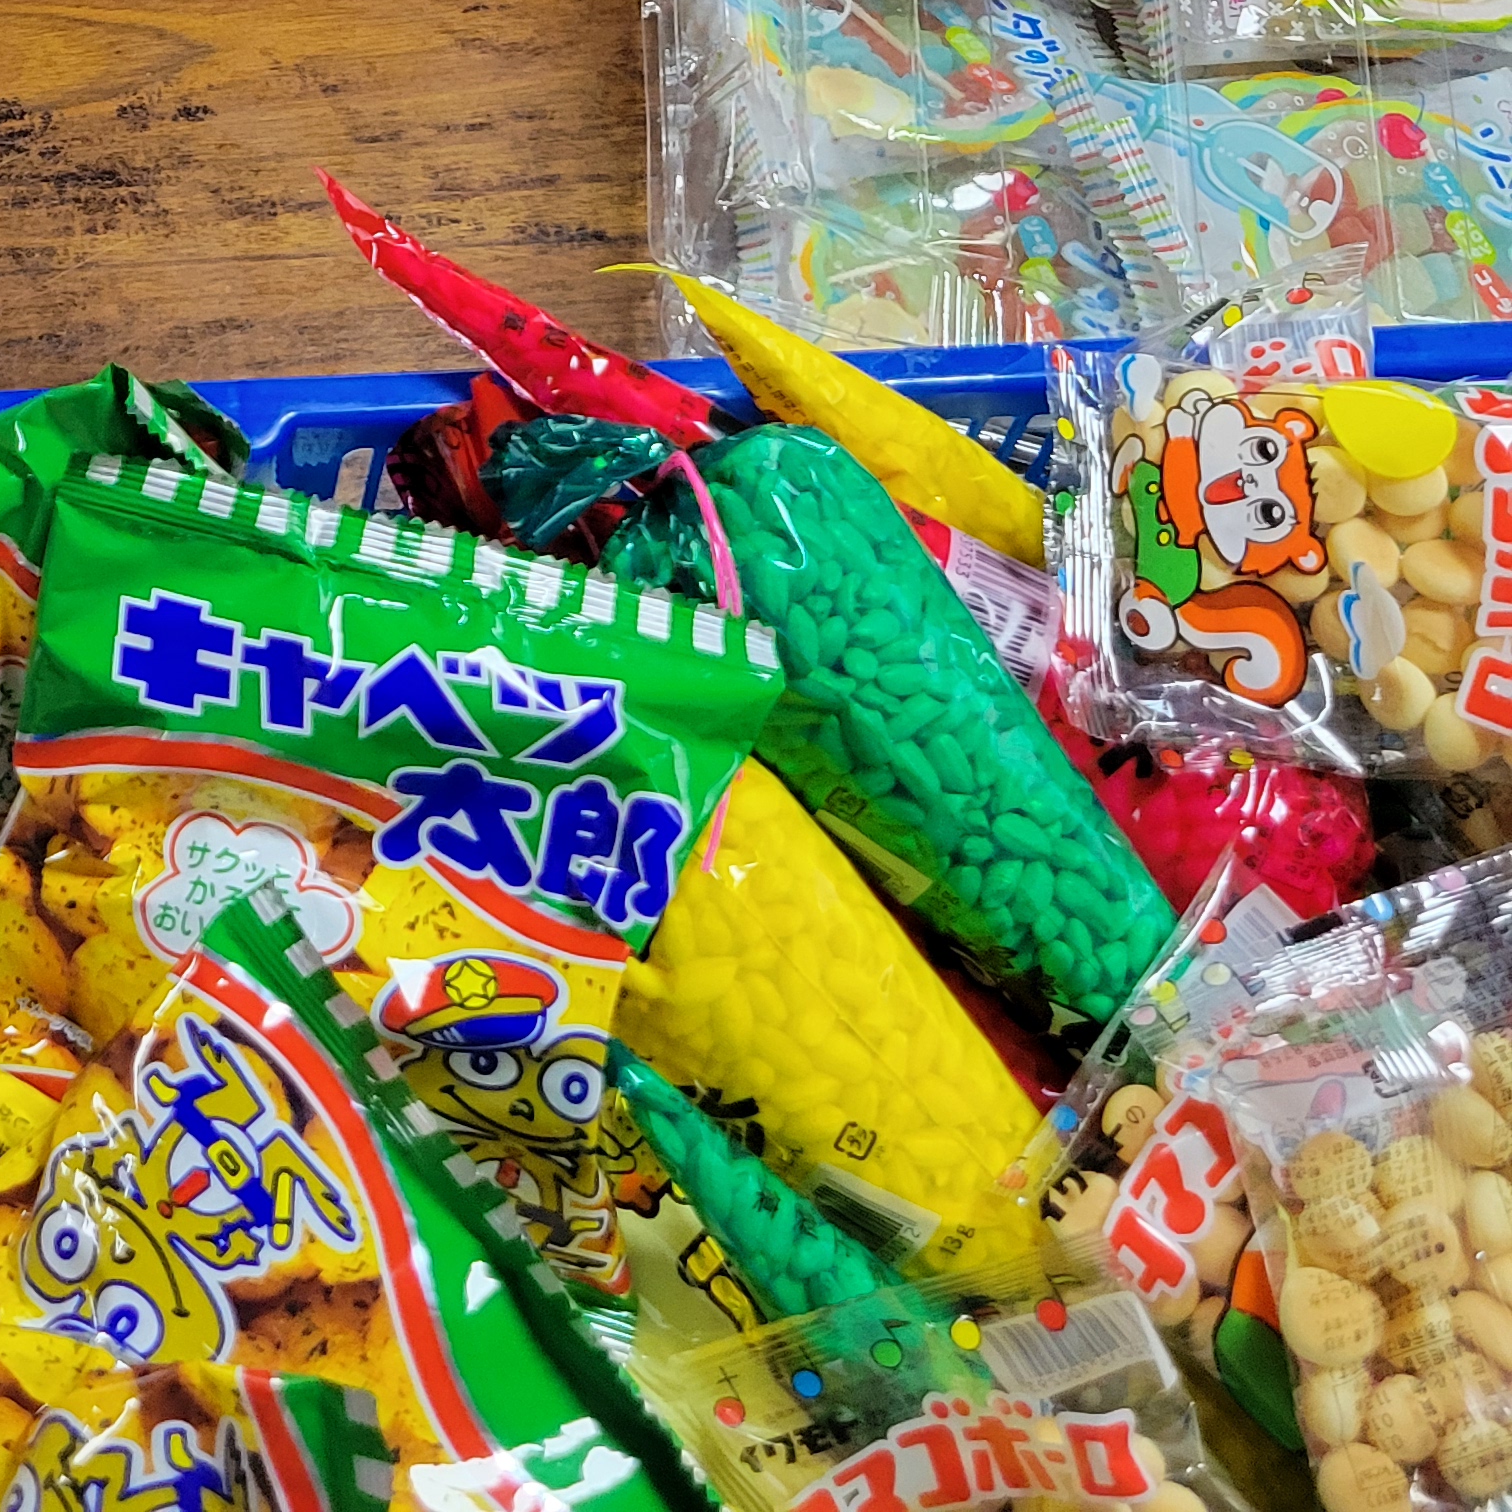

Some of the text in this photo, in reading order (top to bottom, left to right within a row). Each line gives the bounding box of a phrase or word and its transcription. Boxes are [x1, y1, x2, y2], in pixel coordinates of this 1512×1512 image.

[113, 588, 625, 767] キャベツ
[372, 760, 688, 929] 太郎
